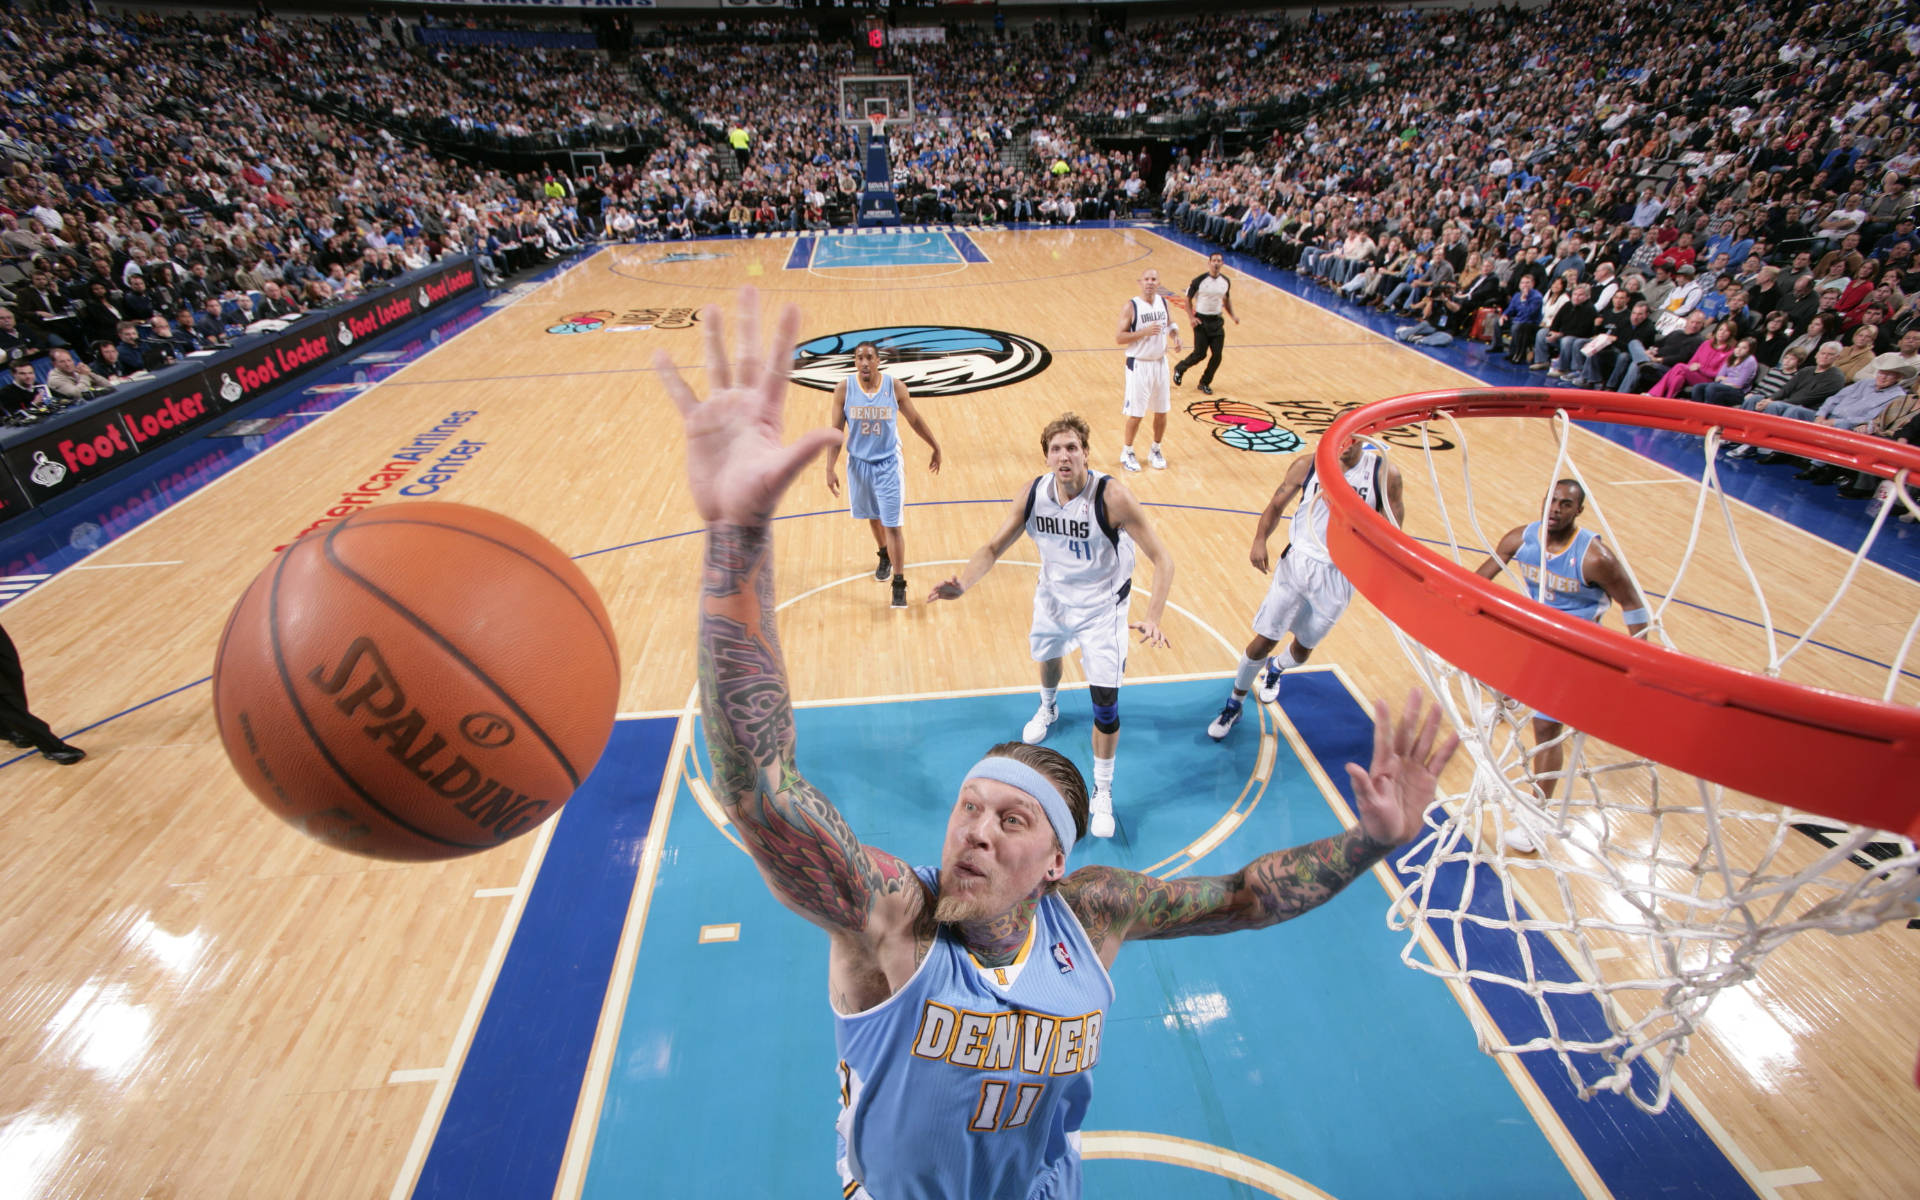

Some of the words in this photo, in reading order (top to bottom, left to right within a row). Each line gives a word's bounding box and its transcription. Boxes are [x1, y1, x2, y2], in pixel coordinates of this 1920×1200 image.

[426, 283, 449, 302] Foot
[446, 270, 474, 293] Locker
[349, 313, 379, 340] Foot
[375, 297, 413, 326] Locker
[235, 355, 279, 393] Foot
[275, 335, 330, 373] Locker
[58, 423, 129, 474] Foot
[123, 392, 207, 443] Locker
[848, 406, 893, 420] DENVER
[861, 422, 881, 436] 24
[398, 439, 487, 497] Center
[1035, 516, 1090, 539] DALLAS
[1068, 540, 1092, 561] 41
[307, 636, 549, 839] SPALDING
[911, 1000, 1103, 1077] DENVER
[968, 1079, 1046, 1132] 11
